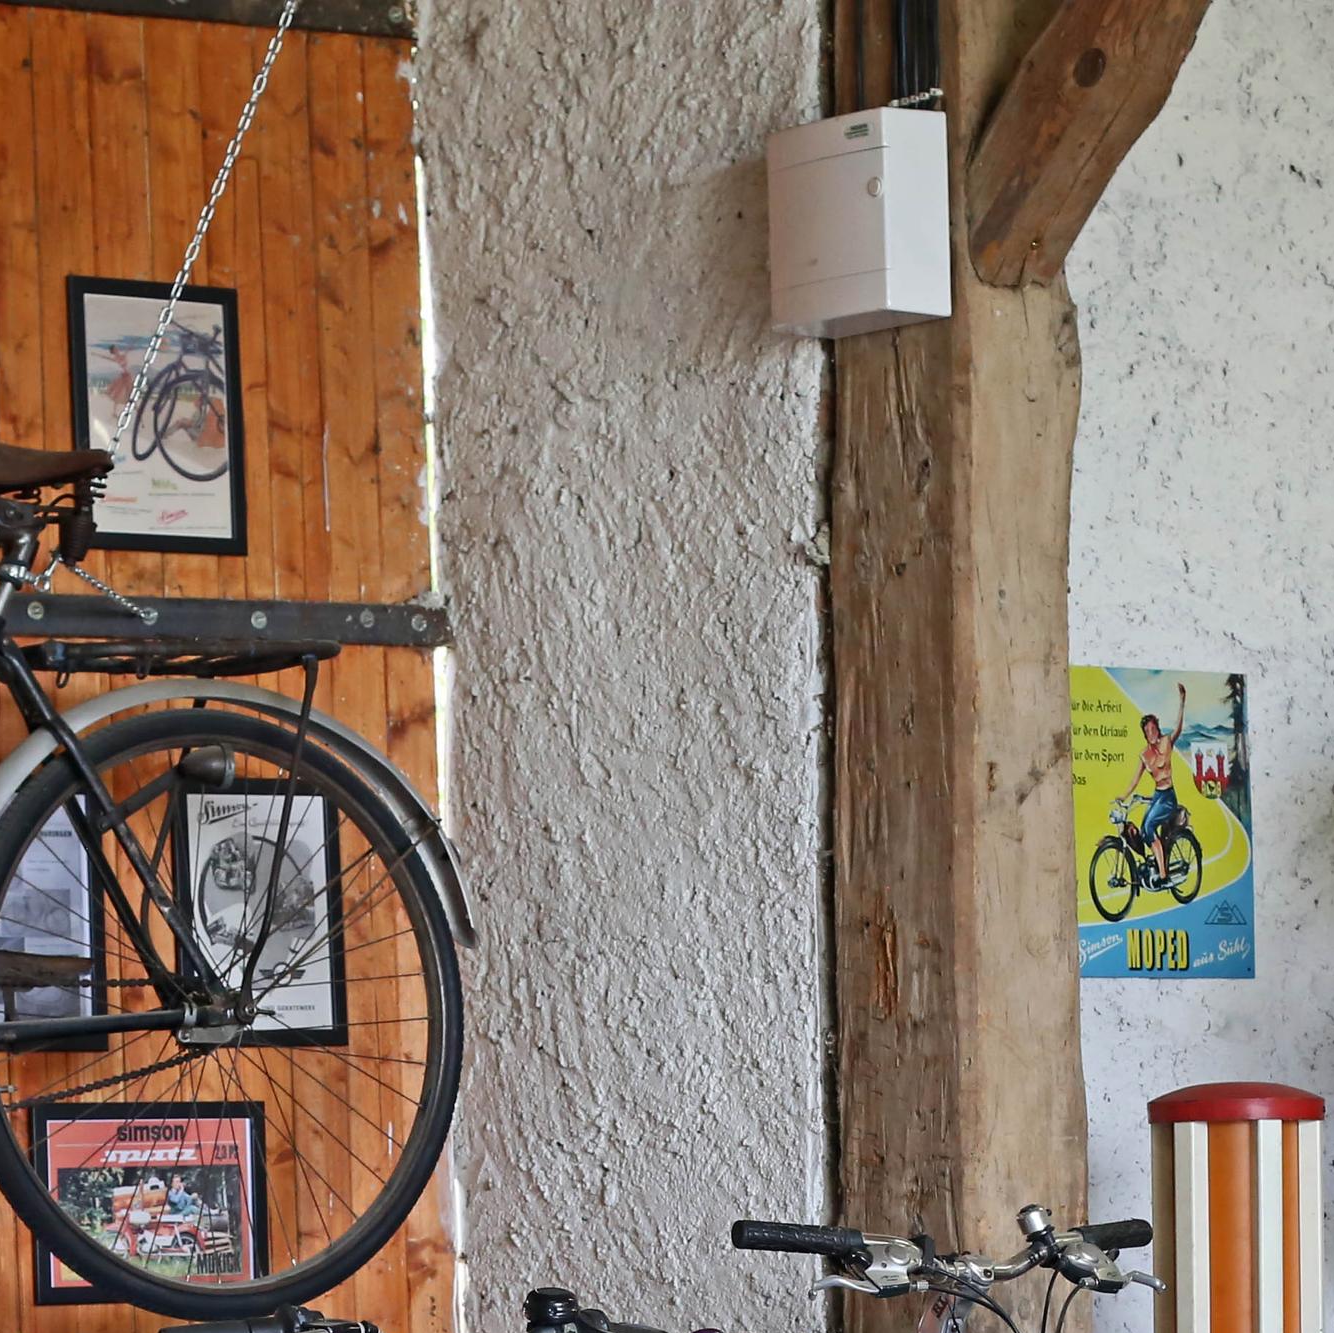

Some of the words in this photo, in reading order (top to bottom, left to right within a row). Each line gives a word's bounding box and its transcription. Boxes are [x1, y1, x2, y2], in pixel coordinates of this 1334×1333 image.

[1096, 699, 1122, 713] Arbeit
[1083, 724, 1098, 736] den
[1100, 725, 1128, 737] Urlaub
[1085, 749, 1100, 761] den
[1101, 749, 1125, 767] Sport
[1126, 928, 1189, 971] MOPED
[117, 1124, 185, 1142] simson
[197, 1252, 242, 1274] MOKICK
